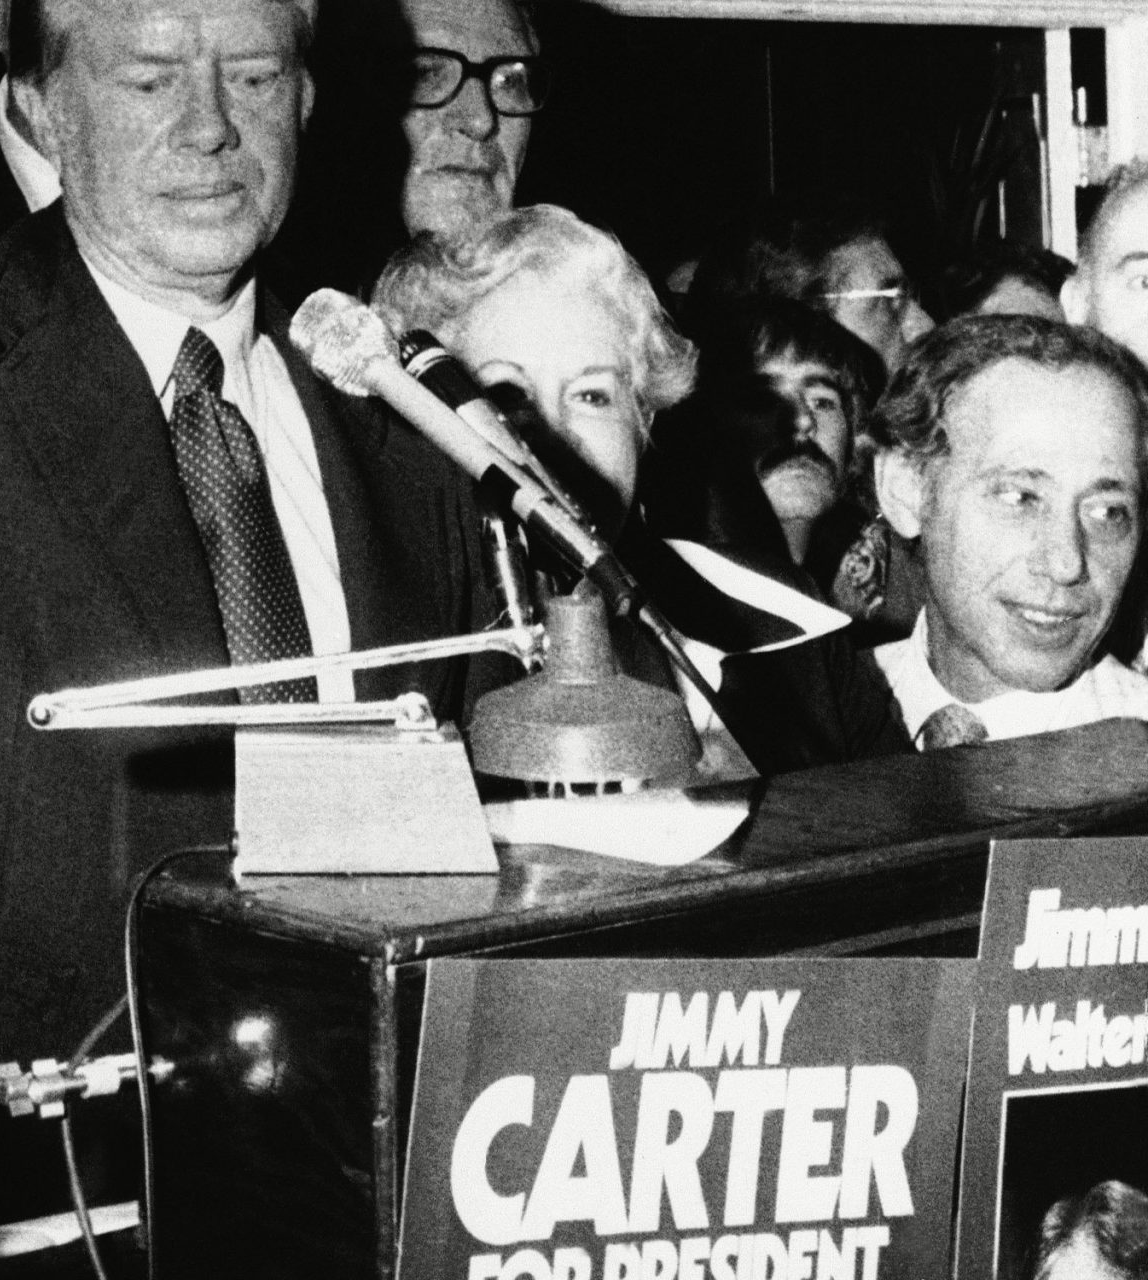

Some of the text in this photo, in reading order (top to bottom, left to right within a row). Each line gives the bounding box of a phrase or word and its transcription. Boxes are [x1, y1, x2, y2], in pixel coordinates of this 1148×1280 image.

[1013, 888, 1148, 970] Jimm
[609, 990, 802, 1070] JIMMY
[1008, 999, 1148, 1076] Walter
[451, 1065, 919, 1245] CARTER
[602, 1226, 890, 1280] PRESIDENT
